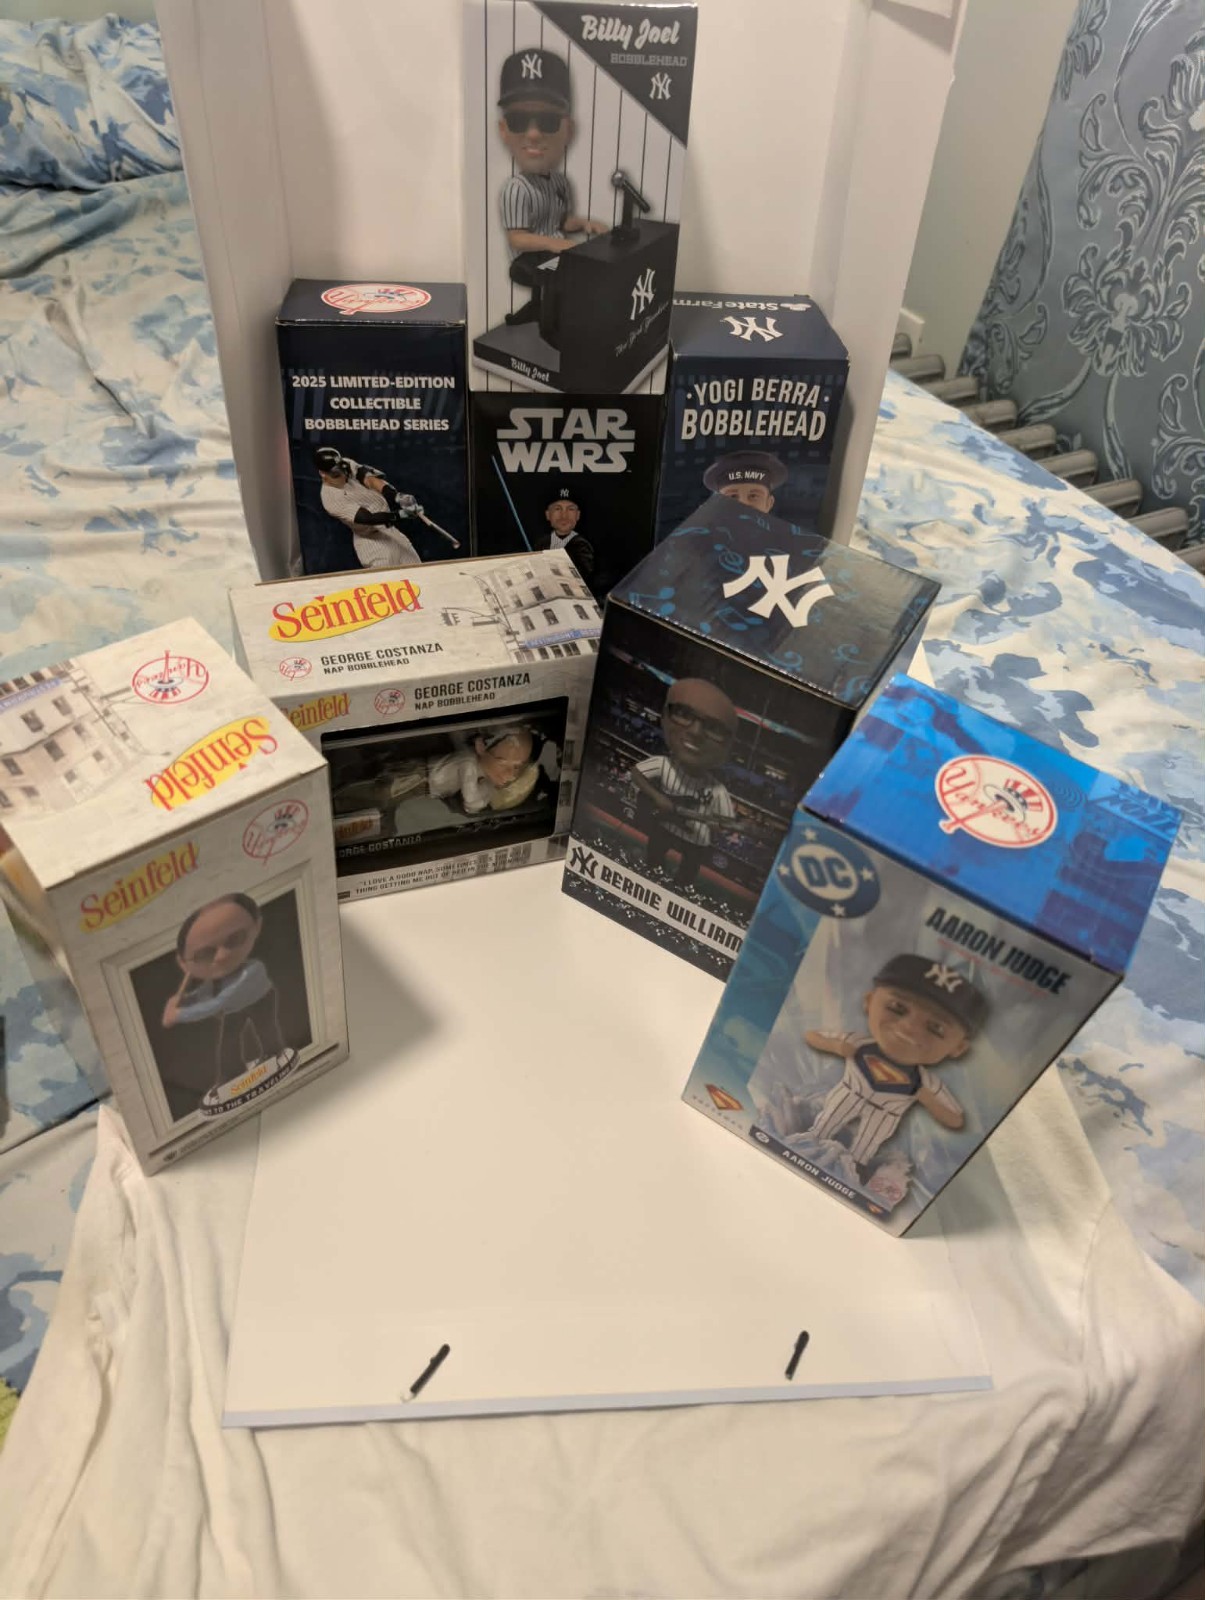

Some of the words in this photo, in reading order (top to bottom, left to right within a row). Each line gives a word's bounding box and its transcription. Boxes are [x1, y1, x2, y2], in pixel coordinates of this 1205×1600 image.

[580, 14, 633, 50] Billy
[634, 19, 680, 50] Joel
[610, 53, 688, 66] BOBBLEHEAD
[292, 376, 327, 388] 2025
[330, 376, 455, 388] LIMITED-EDITION
[510, 357, 531, 377] Billy
[531, 367, 550, 382] Joel
[330, 397, 421, 410] COLLECTIBLE
[694, 378, 744, 406] YOGI
[751, 378, 821, 408] BERRA
[305, 419, 400, 430] BOBBLEHEAD
[403, 419, 449, 431] SERIES
[497, 408, 635, 440] STAR
[681, 409, 826, 441] BOBBLEHEAD
[497, 442, 635, 472] WARS
[728, 471, 743, 481] U.S.
[745, 471, 767, 481] NAVY
[272, 579, 424, 638] Seinfeld
[320, 651, 373, 666] GEORGE
[376, 643, 444, 660] COSTANZA
[324, 666, 344, 675] NAP
[347, 658, 410, 672] BOBBLEHEAD
[415, 682, 464, 700] GEORGE
[468, 673, 531, 693] COSTANZA
[281, 692, 350, 727] einfeld
[415, 701, 434, 711] NAP
[437, 693, 495, 708] BOBBLEHEAD
[144, 718, 278, 811] Seinfeld
[80, 840, 198, 930] Seinfeld
[800, 853, 853, 889] DC
[600, 865, 662, 911] BERNIE
[666, 900, 744, 953] WILLIAM
[926, 907, 1001, 960] AARON
[1002, 943, 1072, 996] JUDGE
[782, 1150, 819, 1176] AARON
[821, 1175, 857, 1199] JUDGE
